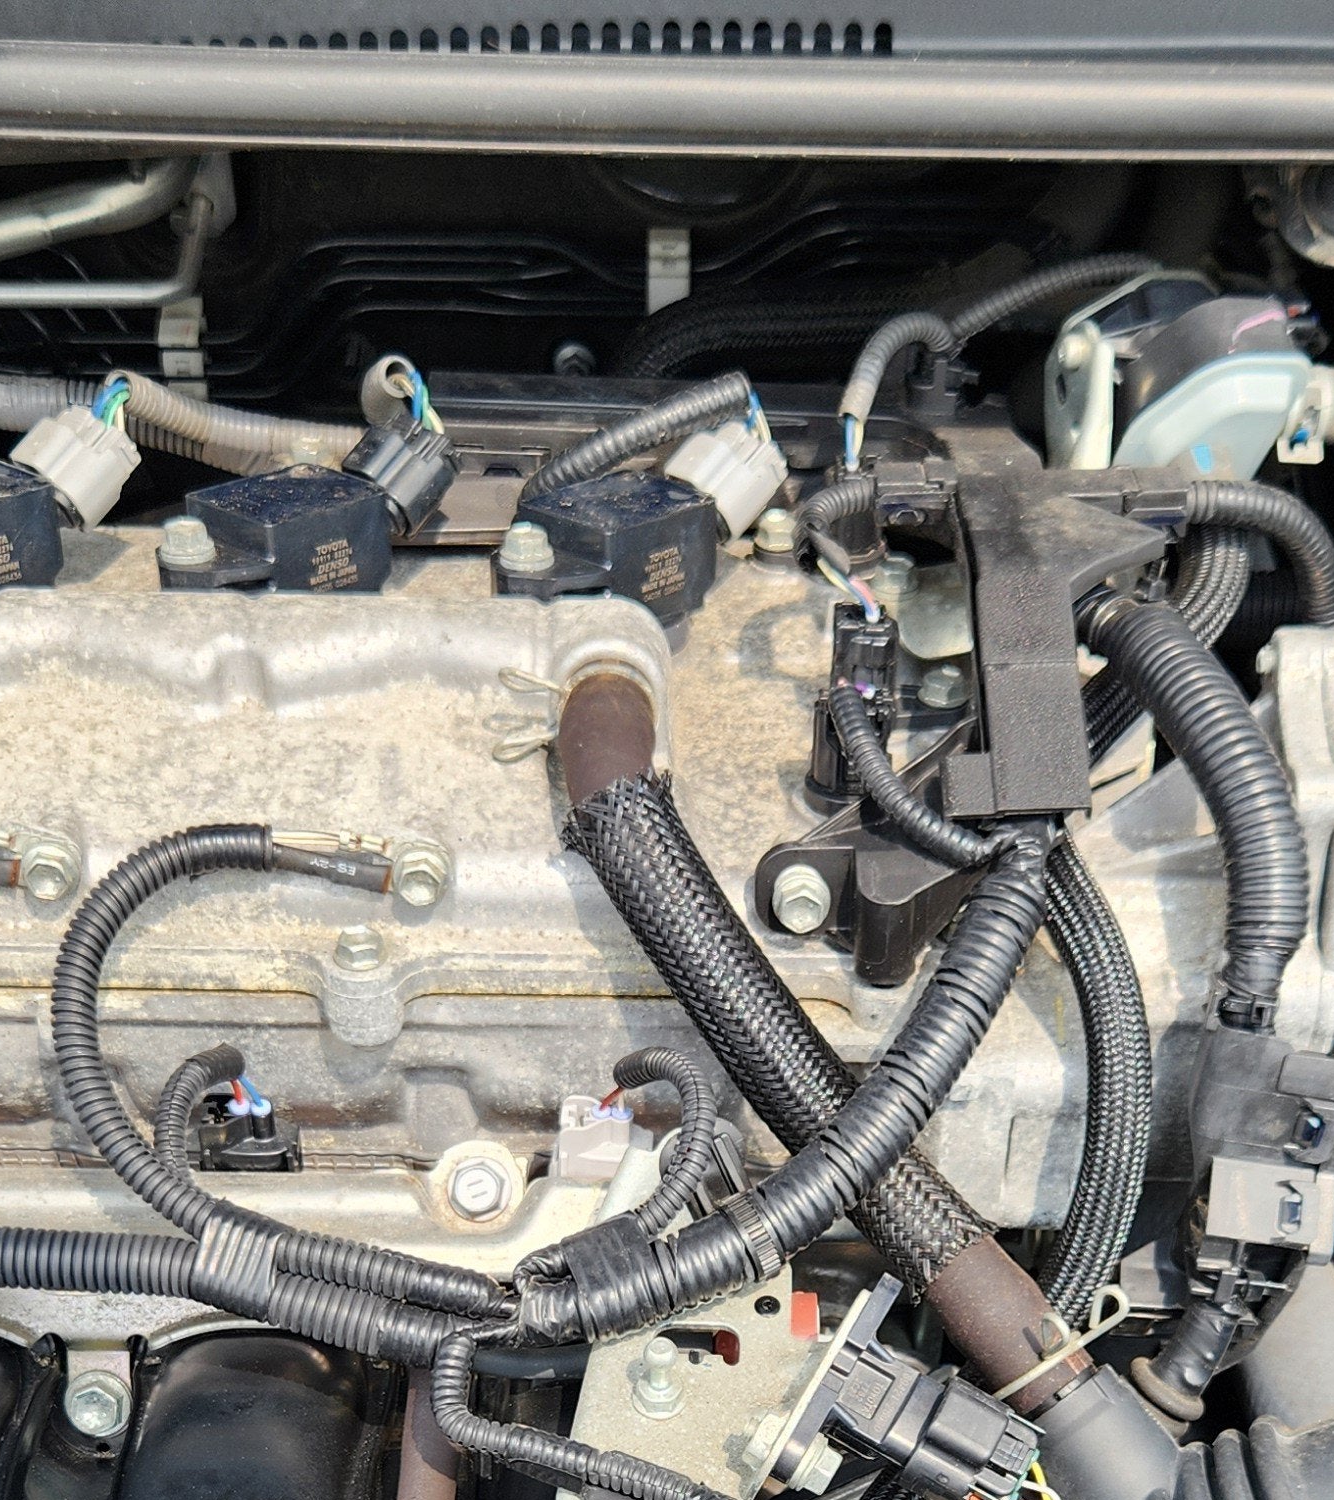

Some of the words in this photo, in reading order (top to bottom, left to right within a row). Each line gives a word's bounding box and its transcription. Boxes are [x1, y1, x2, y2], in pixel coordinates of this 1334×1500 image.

[315, 538, 349, 556] TOYOTA
[649, 547, 679, 563] TOYOTA
[309, 574, 328, 586] MADE
[337, 564, 357, 577] JAPAN
[318, 557, 349, 575] DENSO
[649, 565, 679, 582] DENSO
[641, 581, 658, 593] MADE
[666, 571, 685, 585] JAPAN
[860, 1380, 884, 1415] TOYOTA
